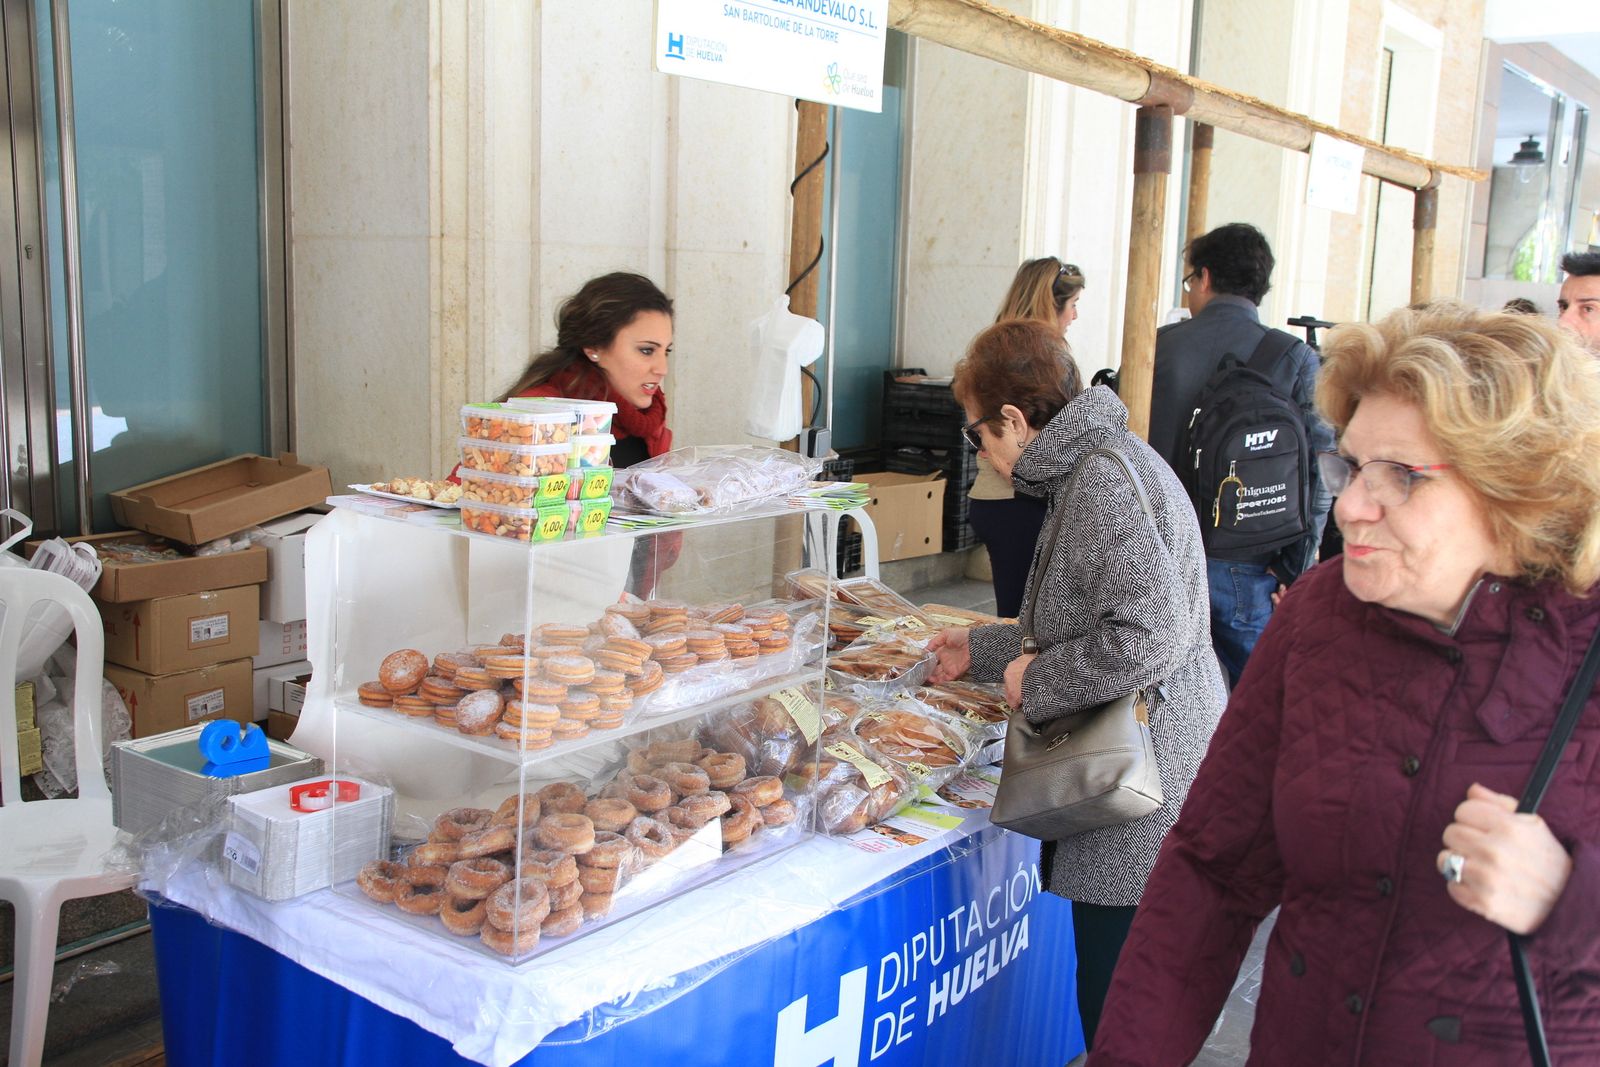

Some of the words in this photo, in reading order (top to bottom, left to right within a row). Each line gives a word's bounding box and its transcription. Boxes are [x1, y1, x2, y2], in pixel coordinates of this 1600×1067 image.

[723, 4, 740, 19] SAN
[742, 9, 791, 31] BARTOLOMÉ
[792, 21, 803, 35] DE
[805, 24, 814, 38] LA
[816, 27, 839, 43] TORRE
[858, 8, 878, 29] S.L.
[668, 32, 684, 55] H
[696, 49, 723, 63] HUELVA
[851, 83, 874, 98] Huelva
[1245, 429, 1279, 447] HTV
[1236, 483, 1287, 498] Chiguagua
[1236, 494, 1287, 510] SPORTJOBS
[877, 861, 1042, 1003] DIPUTACIÓN
[870, 995, 917, 1061] DE
[927, 913, 1029, 1027] HUELVA
